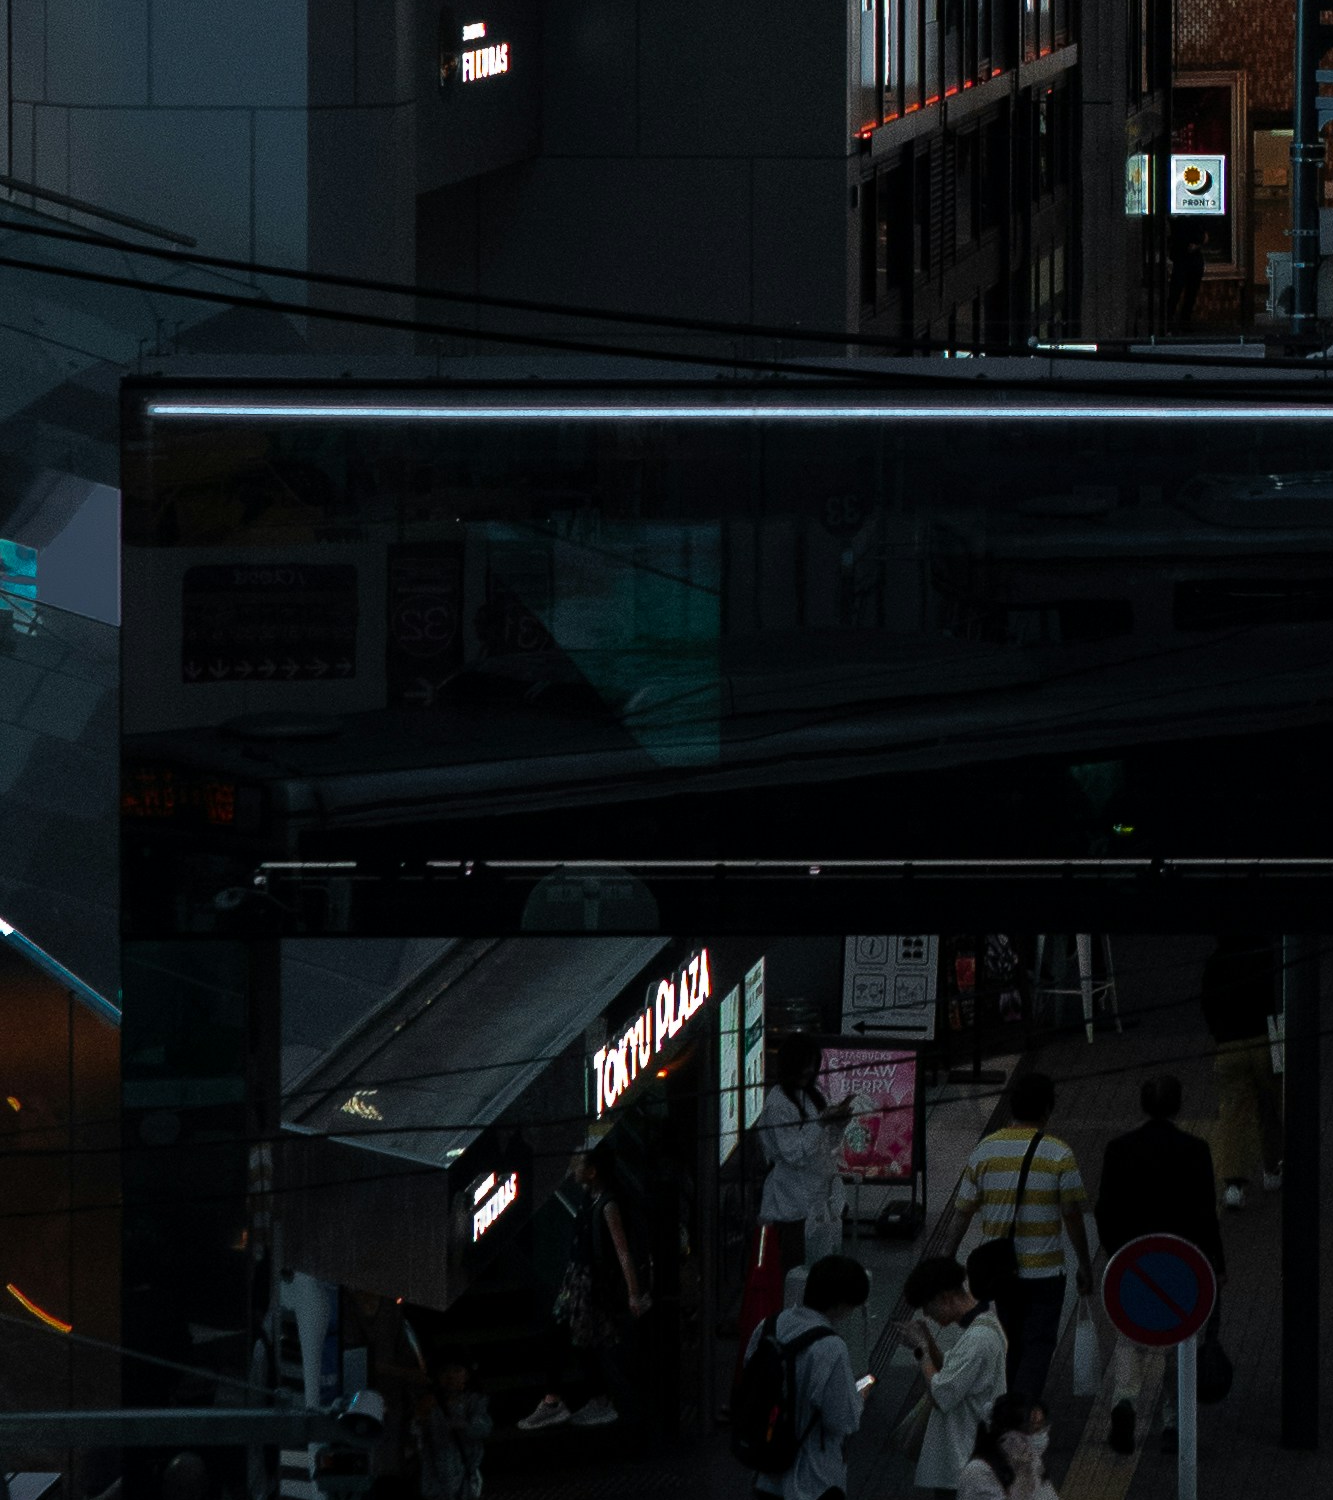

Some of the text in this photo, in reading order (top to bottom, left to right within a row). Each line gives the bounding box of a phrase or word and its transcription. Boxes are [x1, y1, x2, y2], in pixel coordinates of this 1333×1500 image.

[1182, 198, 1217, 207] PRONTO
[593, 947, 713, 1120] TOKYU PLAZA
[840, 1078, 895, 1094] BERRY
